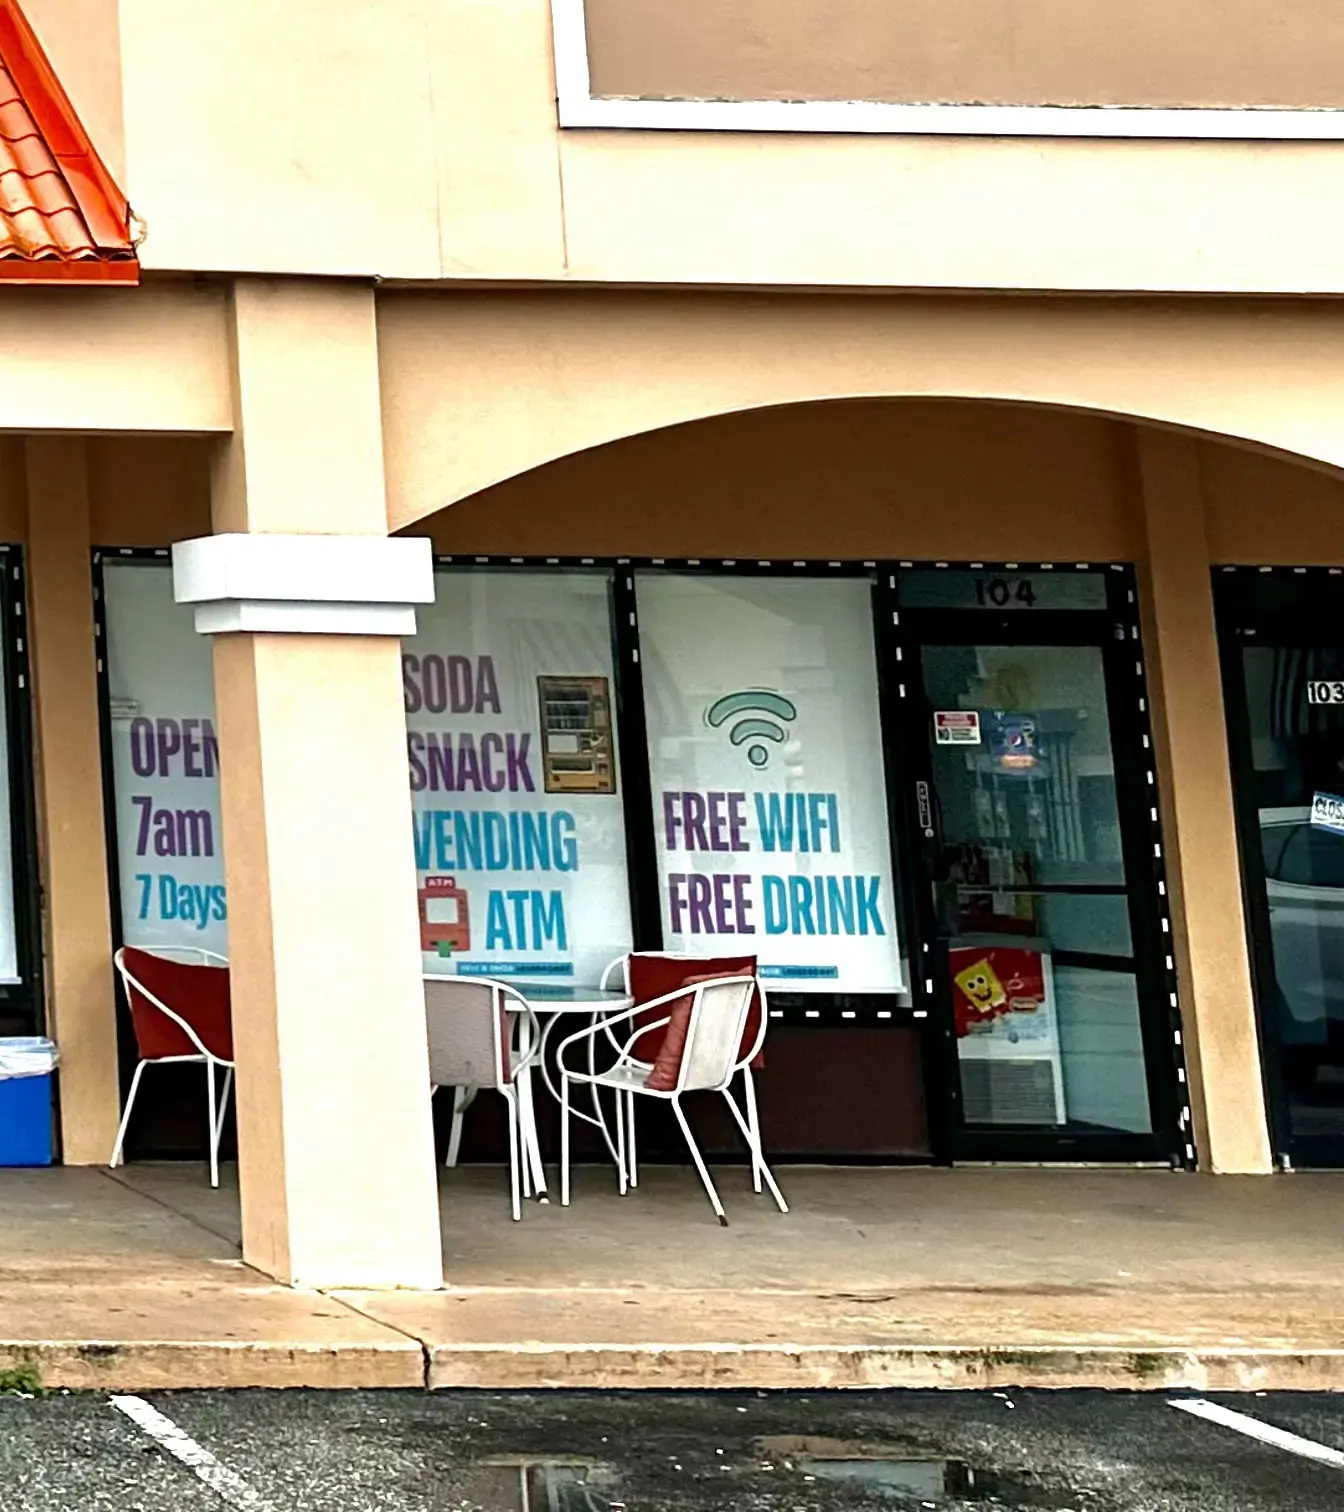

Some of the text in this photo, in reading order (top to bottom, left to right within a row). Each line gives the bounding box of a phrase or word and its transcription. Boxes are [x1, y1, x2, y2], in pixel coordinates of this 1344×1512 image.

[976, 578, 1036, 606] 104
[401, 654, 502, 714] SODA
[130, 717, 220, 778] OPEN
[407, 732, 536, 792] SNACK
[131, 796, 214, 857] 7am
[662, 791, 841, 853] FREE WIFI
[1315, 798, 1344, 819] CLOS
[413, 810, 579, 872] VENDING
[135, 874, 227, 930] 7 Days
[427, 878, 454, 886] ATM
[667, 873, 885, 935] FREE DRINK
[485, 889, 568, 951] ATM
